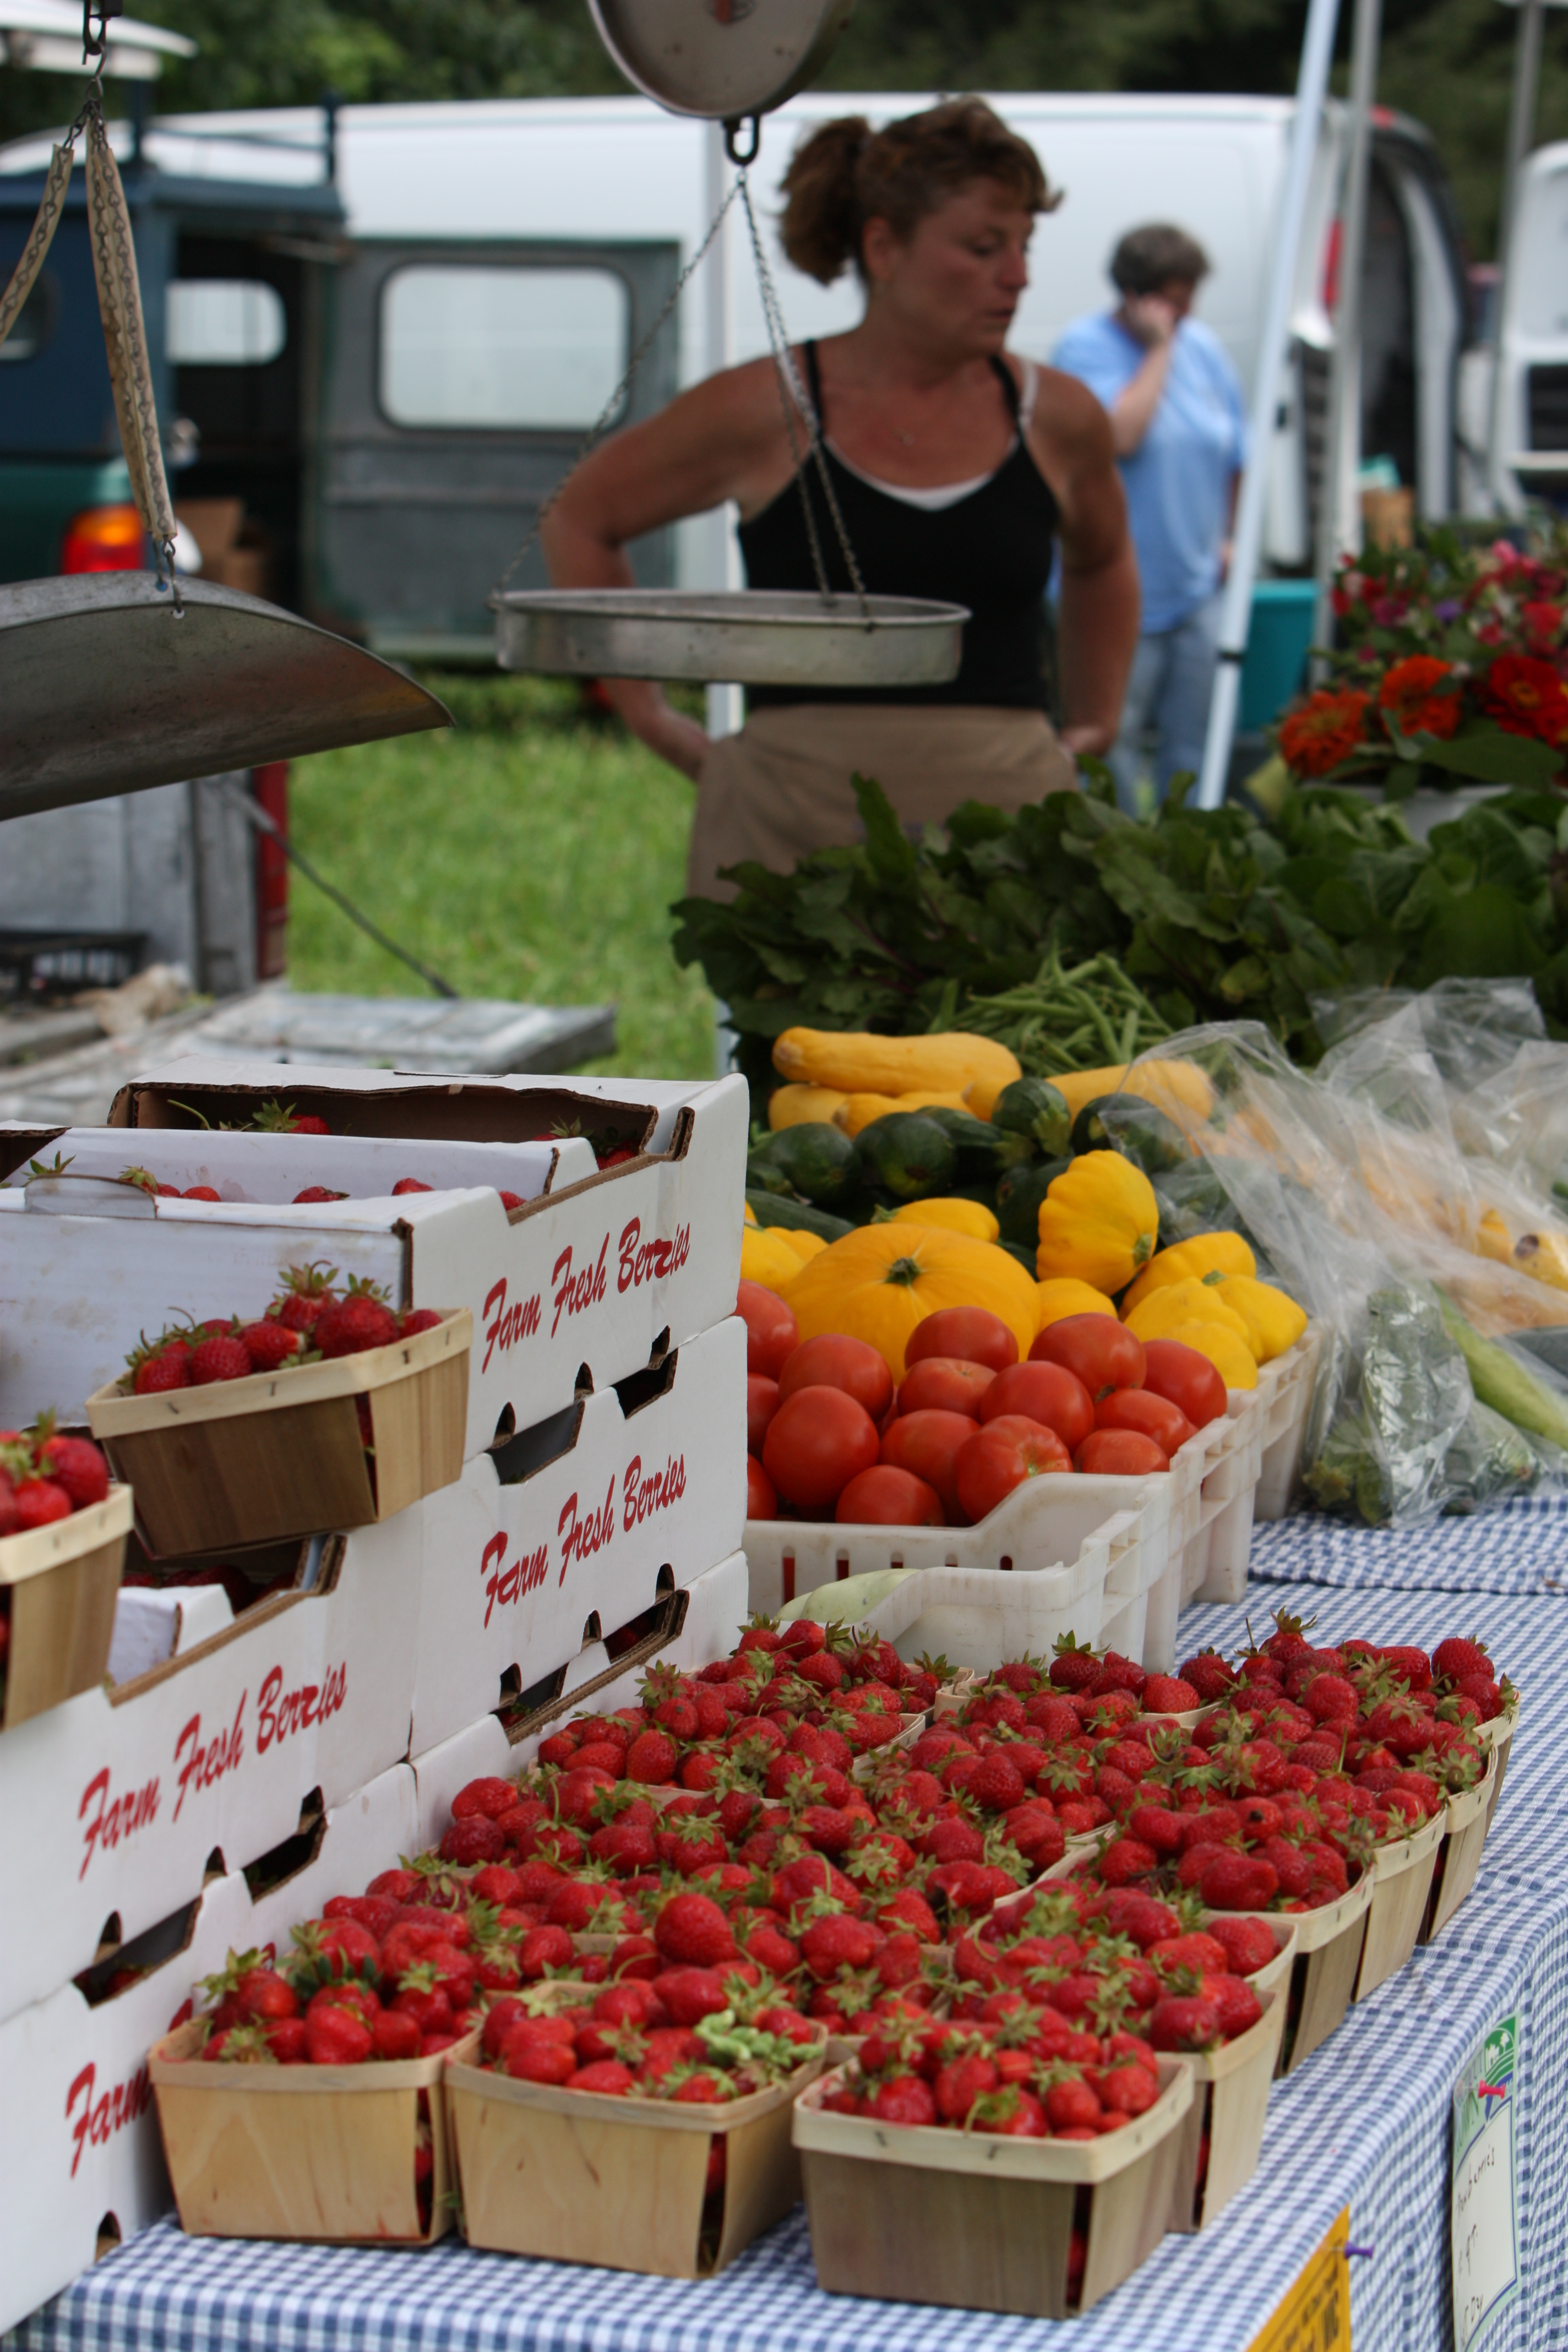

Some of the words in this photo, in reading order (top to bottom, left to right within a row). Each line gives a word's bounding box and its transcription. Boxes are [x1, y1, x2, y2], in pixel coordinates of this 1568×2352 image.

[482, 1277, 541, 1374] Farm
[551, 1232, 609, 1338] Fresh
[617, 1216, 690, 1293] Berries
[481, 1531, 548, 1629] Farm
[558, 1473, 616, 1587] Fresh
[623, 1453, 687, 1532] Berries
[78, 1766, 161, 1882] Farm
[173, 1688, 245, 1823] Fresh
[257, 1661, 347, 1755] Berries
[65, 2061, 153, 2179] Farm
